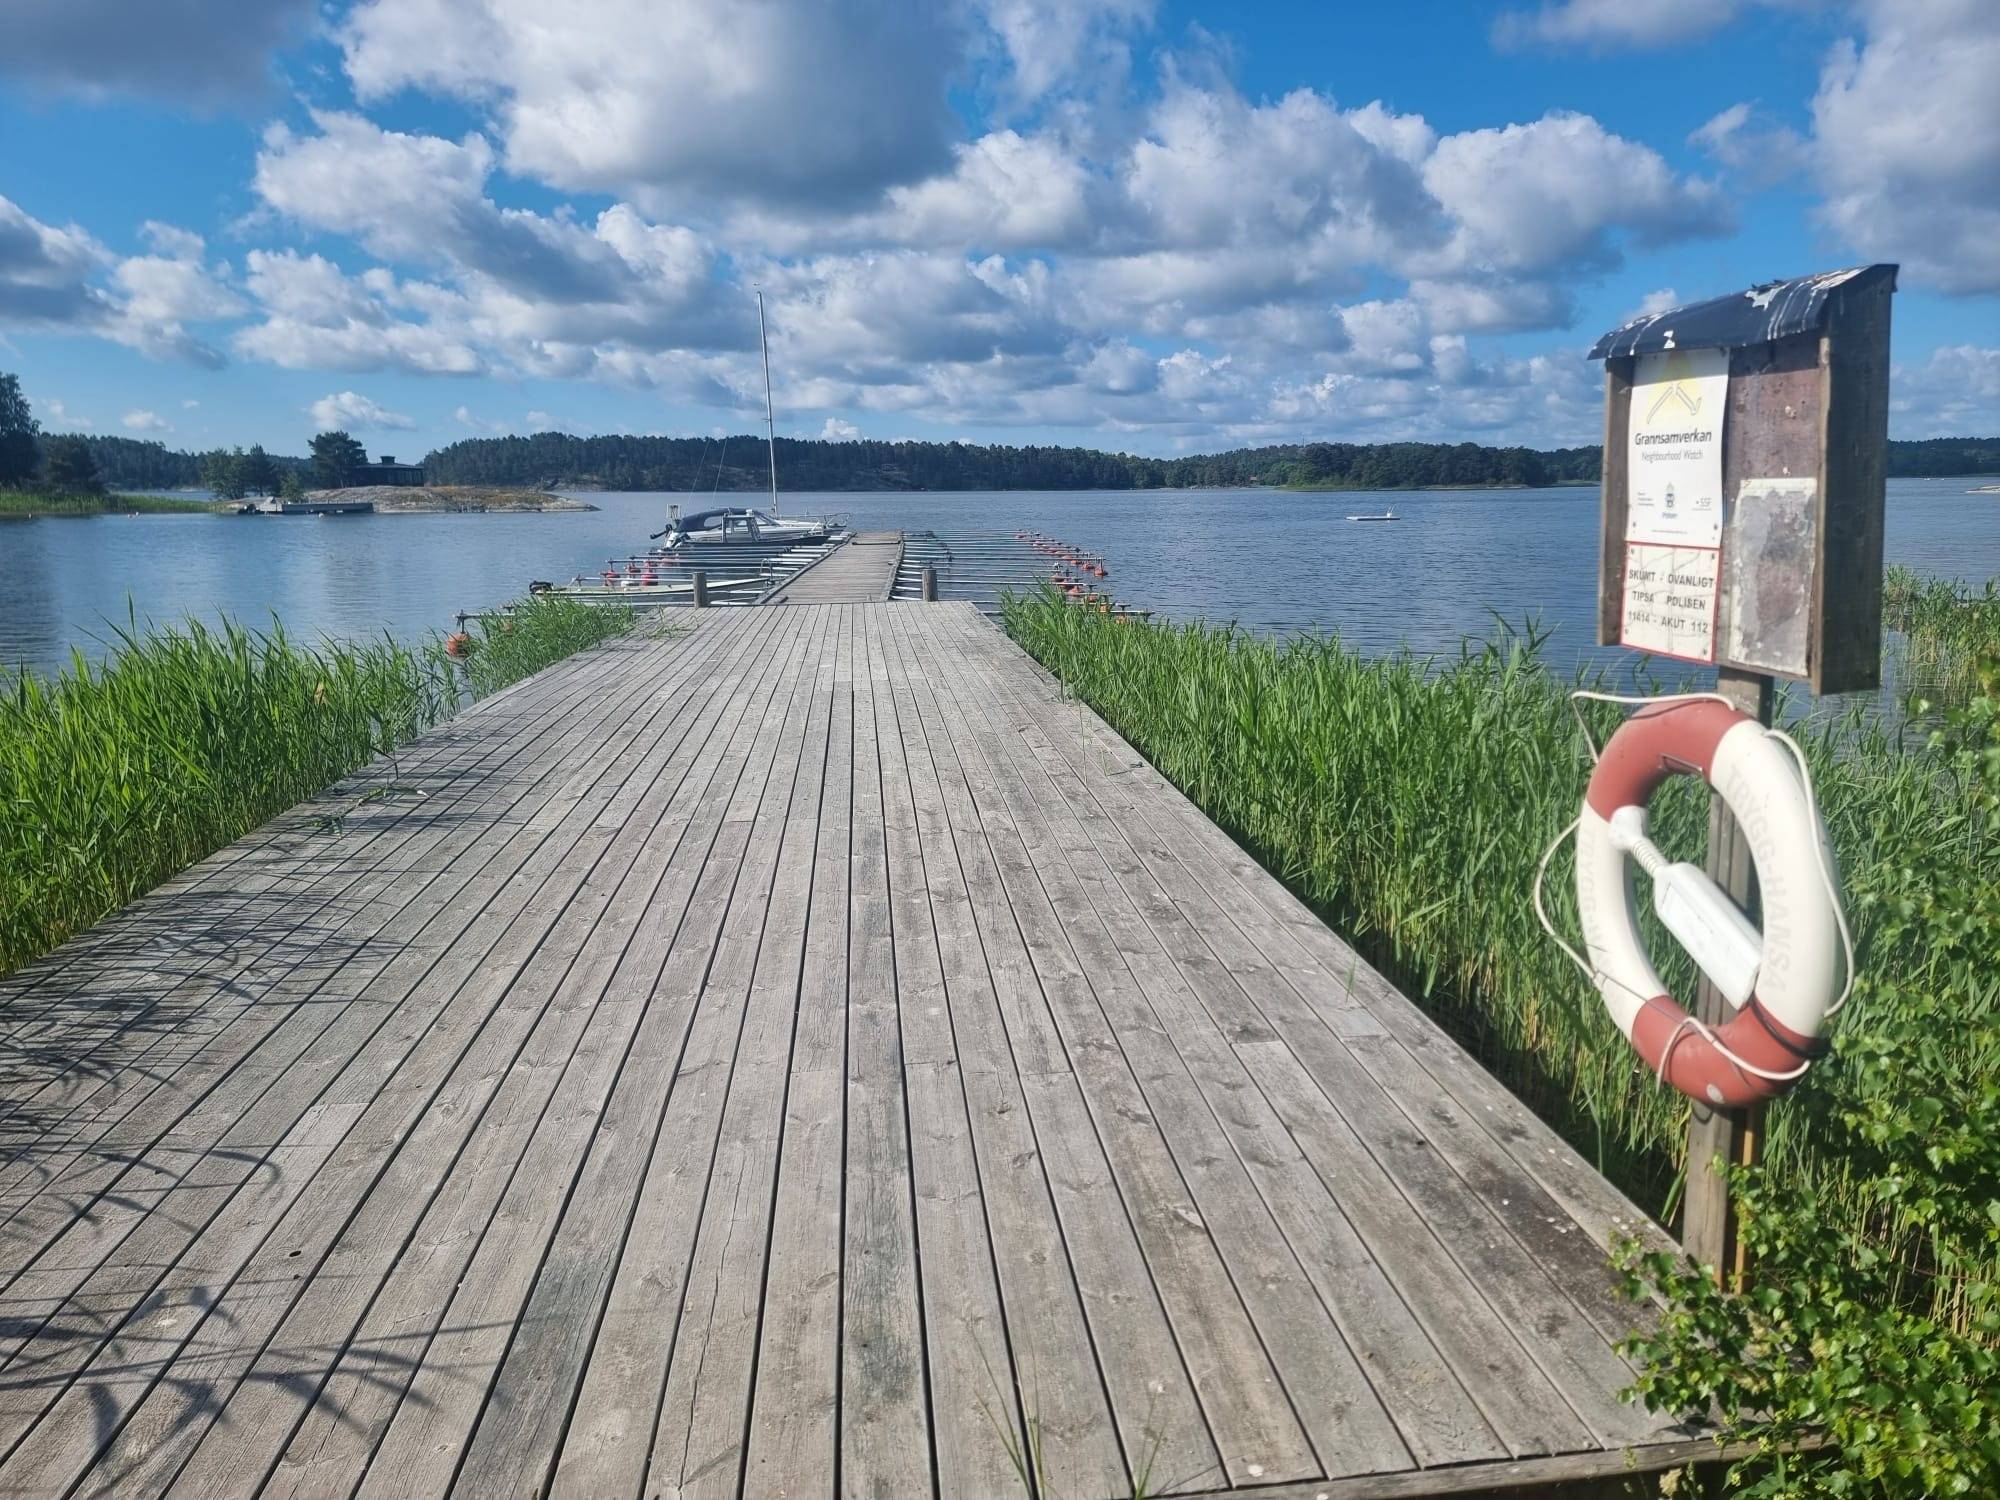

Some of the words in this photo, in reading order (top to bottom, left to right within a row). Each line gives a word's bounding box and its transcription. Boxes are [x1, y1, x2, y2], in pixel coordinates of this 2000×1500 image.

[1635, 428, 1712, 445] Grannsamverkan
[1668, 573, 1714, 588] OVANLIGT
[1632, 590, 1655, 603] TIPSA
[1666, 595, 1706, 610] POLISEN
[1628, 611, 1650, 623] 11414
[1660, 616, 1686, 630] AKUT
[1691, 621, 1709, 634] 112
